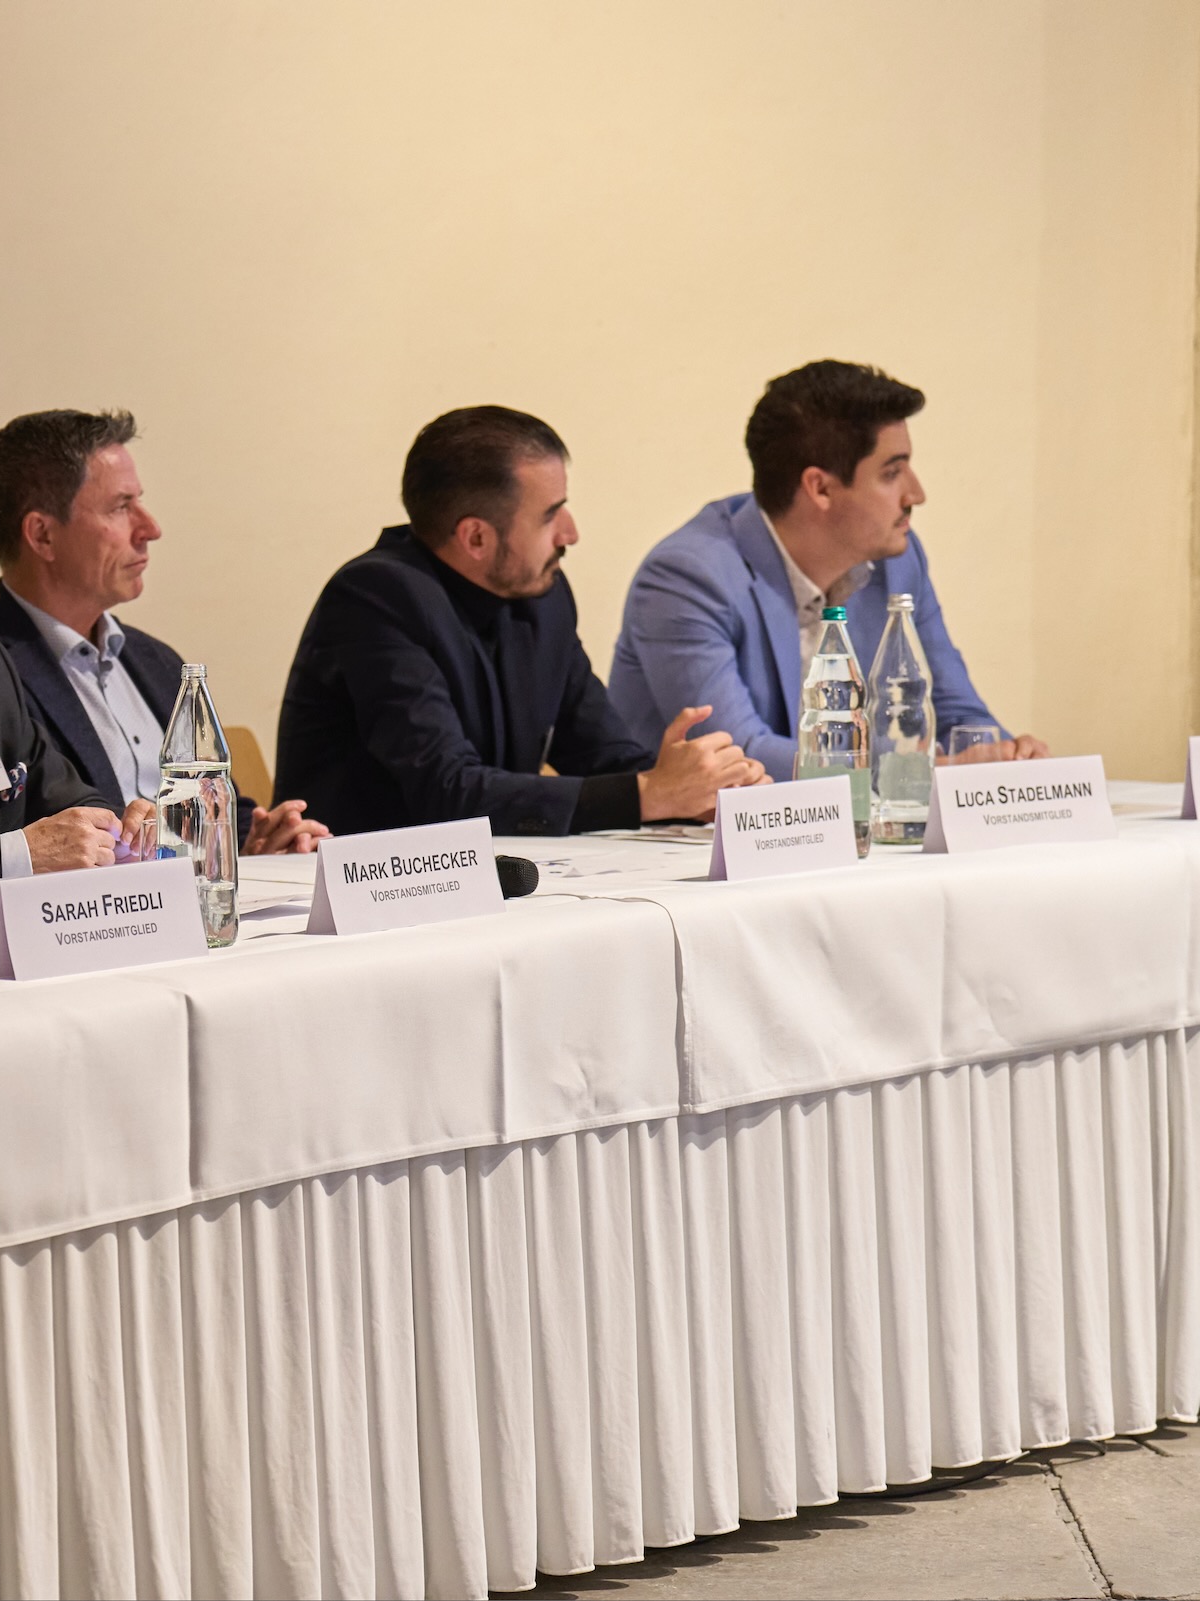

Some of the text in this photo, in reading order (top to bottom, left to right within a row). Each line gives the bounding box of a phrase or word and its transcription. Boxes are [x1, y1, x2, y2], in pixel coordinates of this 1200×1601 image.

[955, 782, 1092, 808] LUCA STADELMANN
[735, 804, 840, 832] WALTER BAUMANN
[983, 809, 1072, 825] VORSTANDSMITGLIED
[755, 833, 824, 851] VORSTANDSMITGLIED
[343, 849, 478, 884] MARK BUCHECKER
[370, 880, 460, 903] VORSTANDSMITGLIED
[41, 892, 163, 924] SARAH FRIEDLI
[55, 922, 158, 946] VORSTANDSMITGLIED
